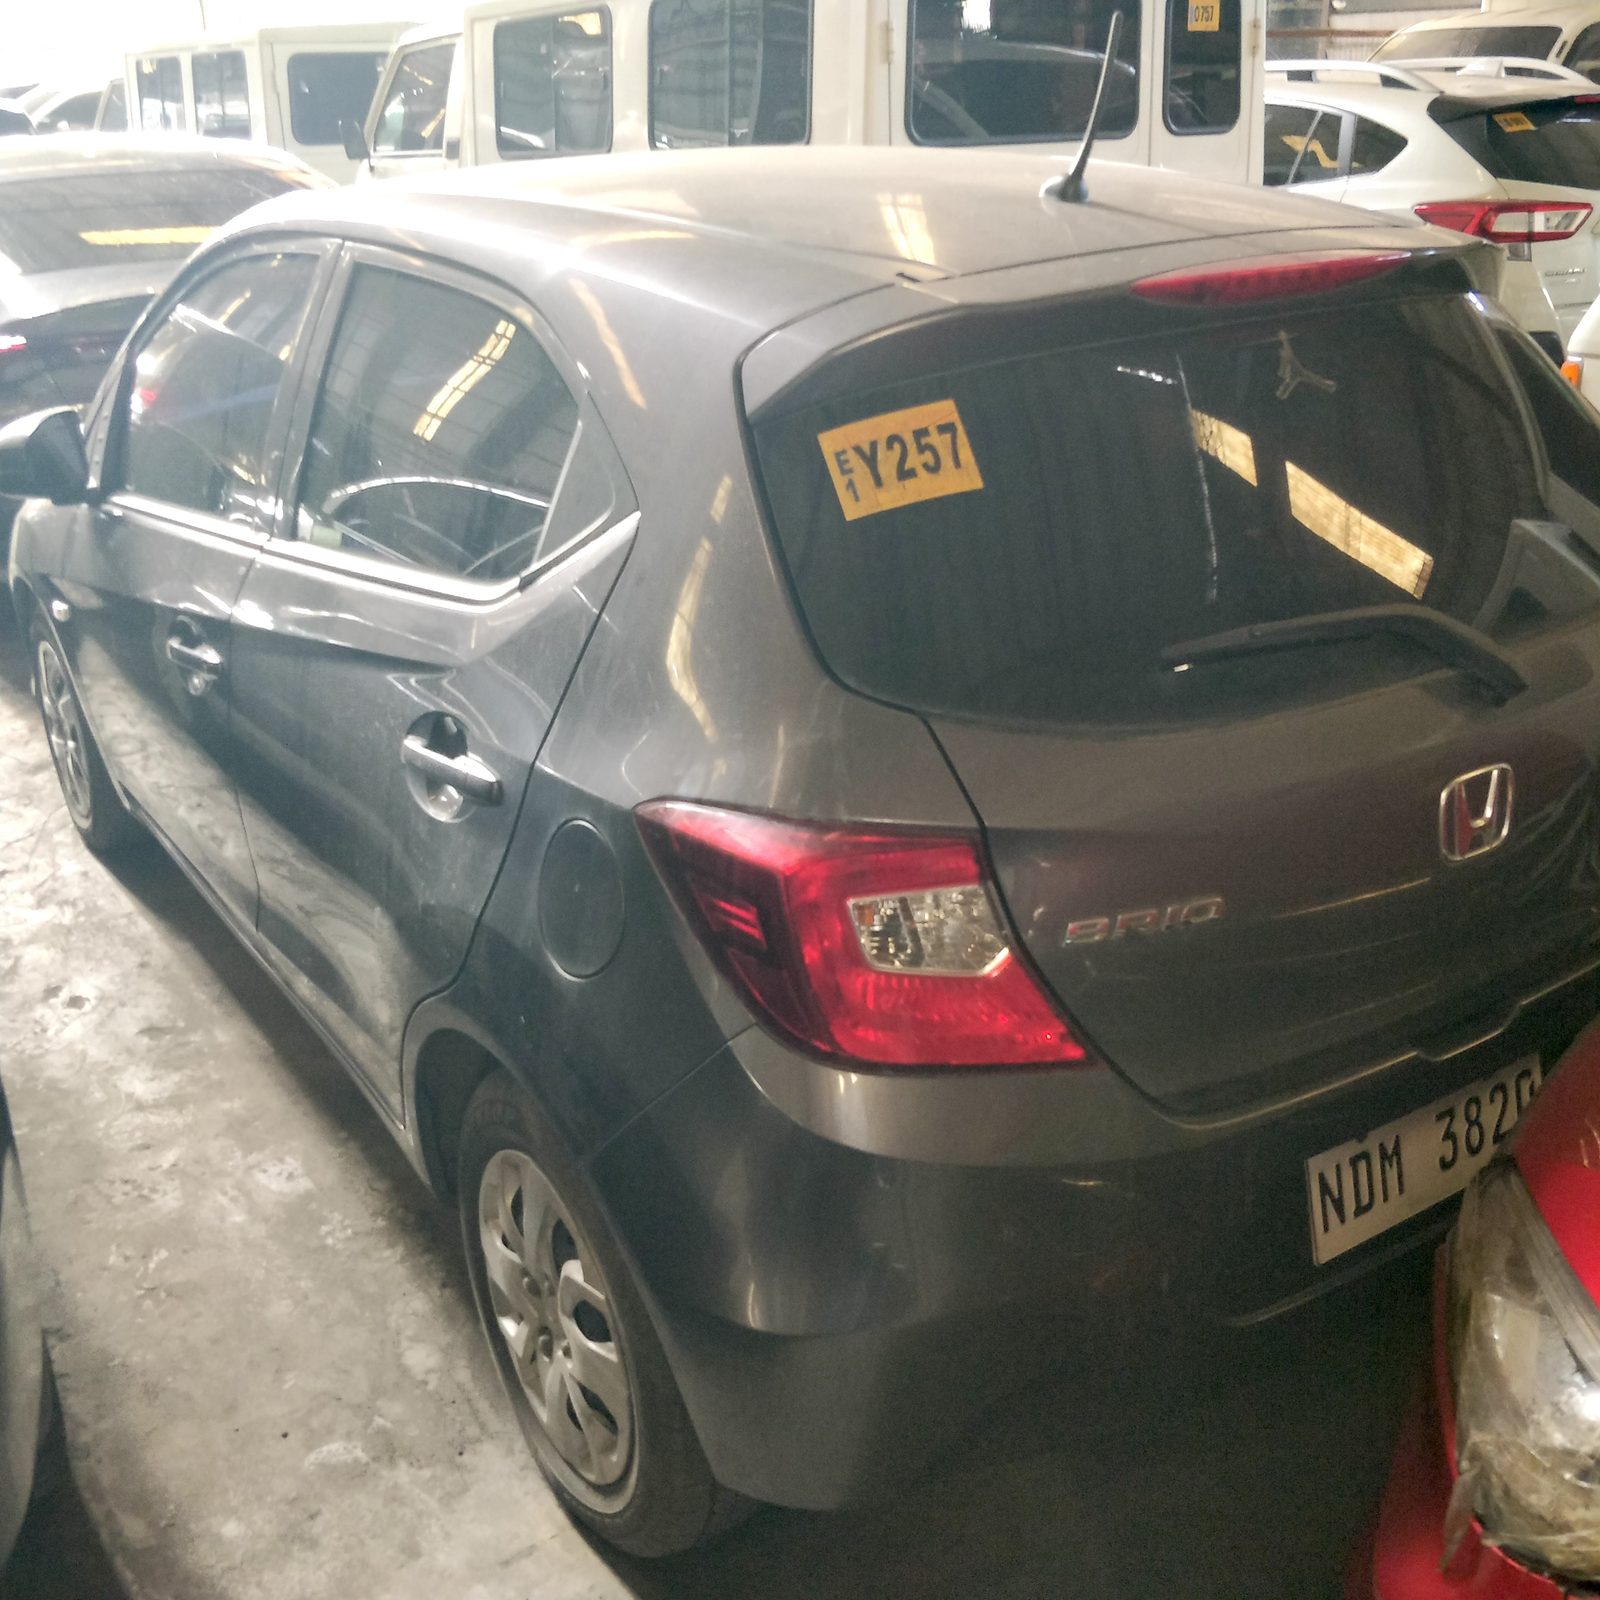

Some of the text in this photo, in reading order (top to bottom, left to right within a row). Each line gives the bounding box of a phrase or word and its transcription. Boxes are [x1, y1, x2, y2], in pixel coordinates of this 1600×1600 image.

[852, 421, 962, 488] Y257
[1061, 897, 1224, 947] BRIO
[1318, 1134, 1405, 1233] NDM
